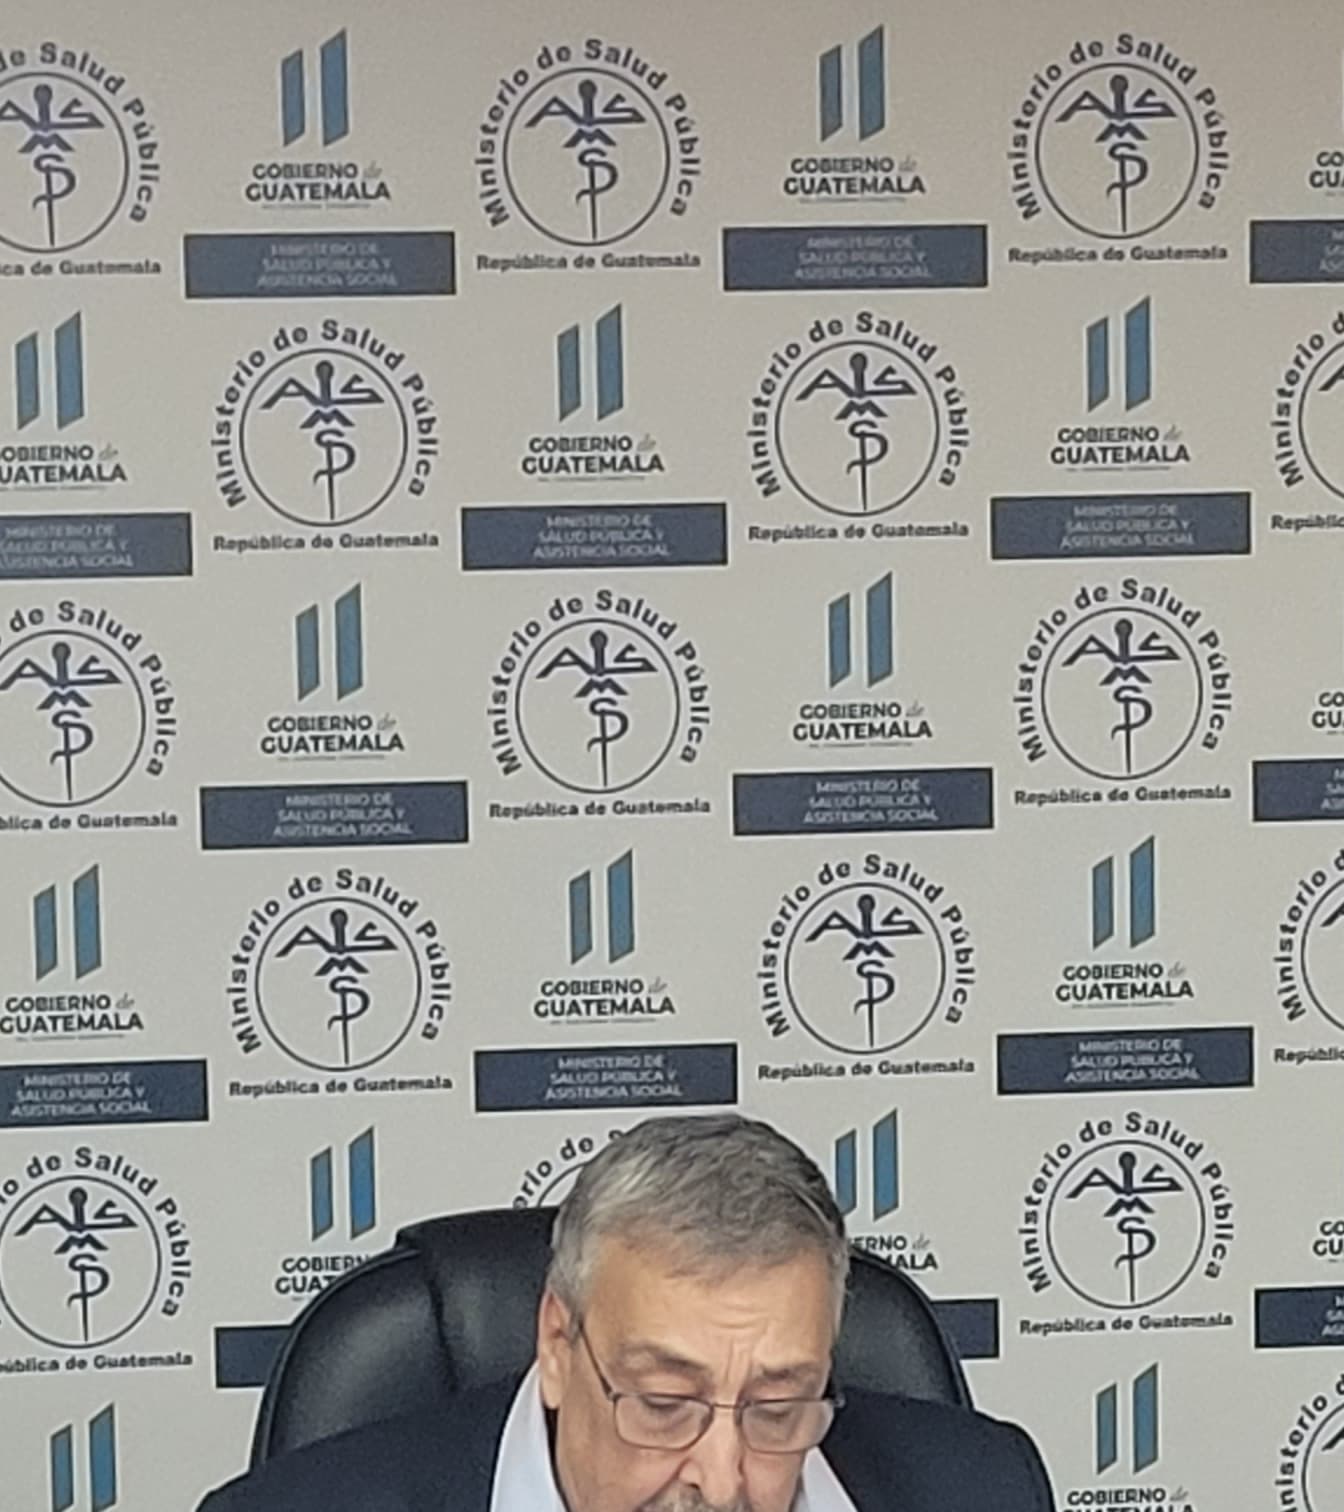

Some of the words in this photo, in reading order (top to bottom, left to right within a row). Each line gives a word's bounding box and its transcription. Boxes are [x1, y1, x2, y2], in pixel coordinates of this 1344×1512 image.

[40, 42, 125, 95] Salud
[123, 98, 160, 222] Pública
[1008, 65, 1062, 220] Ministerio
[1070, 41, 1103, 65] de
[1117, 33, 1197, 85] Salud
[1195, 88, 1229, 209] Pública
[252, 162, 358, 179] GOBIERNO
[245, 182, 391, 201] GUATEMALA
[1009, 248, 1098, 265] República
[1103, 247, 1125, 261] de
[1130, 246, 1228, 260] Guatemala
[31, 261, 53, 275] de
[59, 259, 161, 274] Guatemala
[1271, 334, 1324, 488] Ministerio
[1057, 425, 1159, 443] GOBIERNO
[1050, 444, 1190, 465] GUATEMALA
[487, 621, 541, 776] Ministerio
[549, 598, 583, 621] de
[595, 590, 677, 640] Salud
[674, 641, 710, 763] Pública
[800, 701, 901, 720] GOBIERNO
[792, 720, 933, 741] GUATEMALA
[489, 802, 579, 820] República
[585, 801, 606, 815] de
[612, 798, 710, 815] Guatemala
[226, 900, 280, 1054] Ministerio
[288, 876, 322, 900] de
[336, 868, 419, 918] Salud
[415, 920, 451, 1040] Pública
[541, 978, 643, 996] GOBIERNO
[533, 996, 675, 1018] GUATEMALA
[229, 1080, 319, 1098] República
[325, 1079, 347, 1093] de
[353, 1076, 452, 1092] Guatemala
